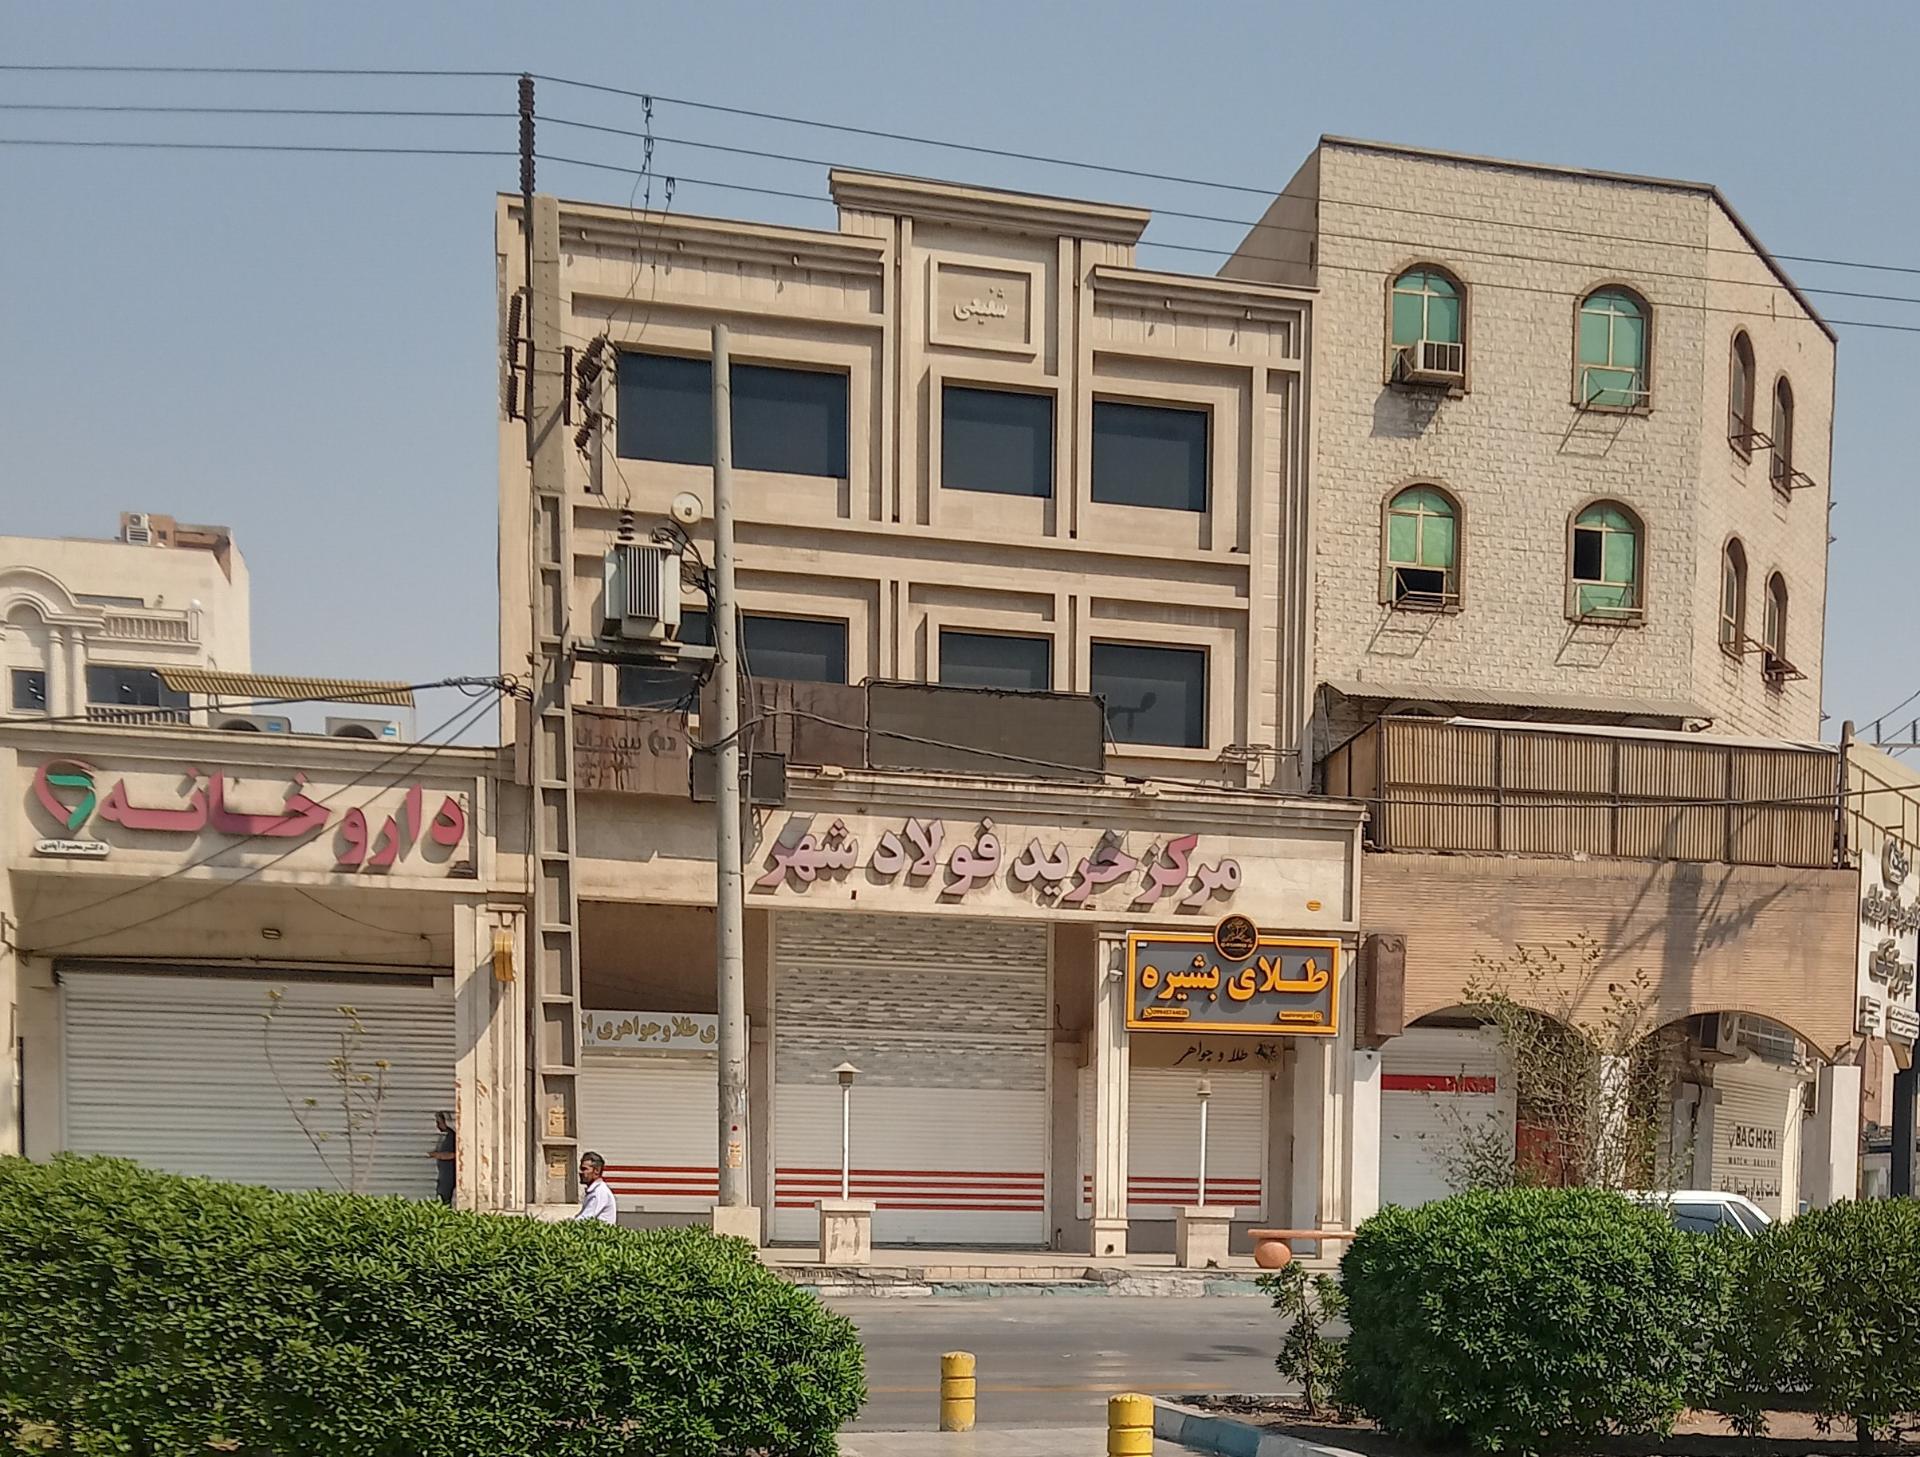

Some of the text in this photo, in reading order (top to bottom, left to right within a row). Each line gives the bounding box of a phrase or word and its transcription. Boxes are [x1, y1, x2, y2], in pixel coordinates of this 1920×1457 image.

[99, 767, 464, 867] داروخانه
[756, 816, 1242, 906] مرکز خرید فولاد شهر
[1142, 954, 1330, 1002] طلای بشیره
[597, 1016, 661, 1041] جواهری
[661, 1024, 671, 1042] و
[672, 1015, 699, 1037] طلا
[1172, 1039, 1248, 1066] طلا و جواهر
[1736, 1126, 1776, 1150] BAGHERI
